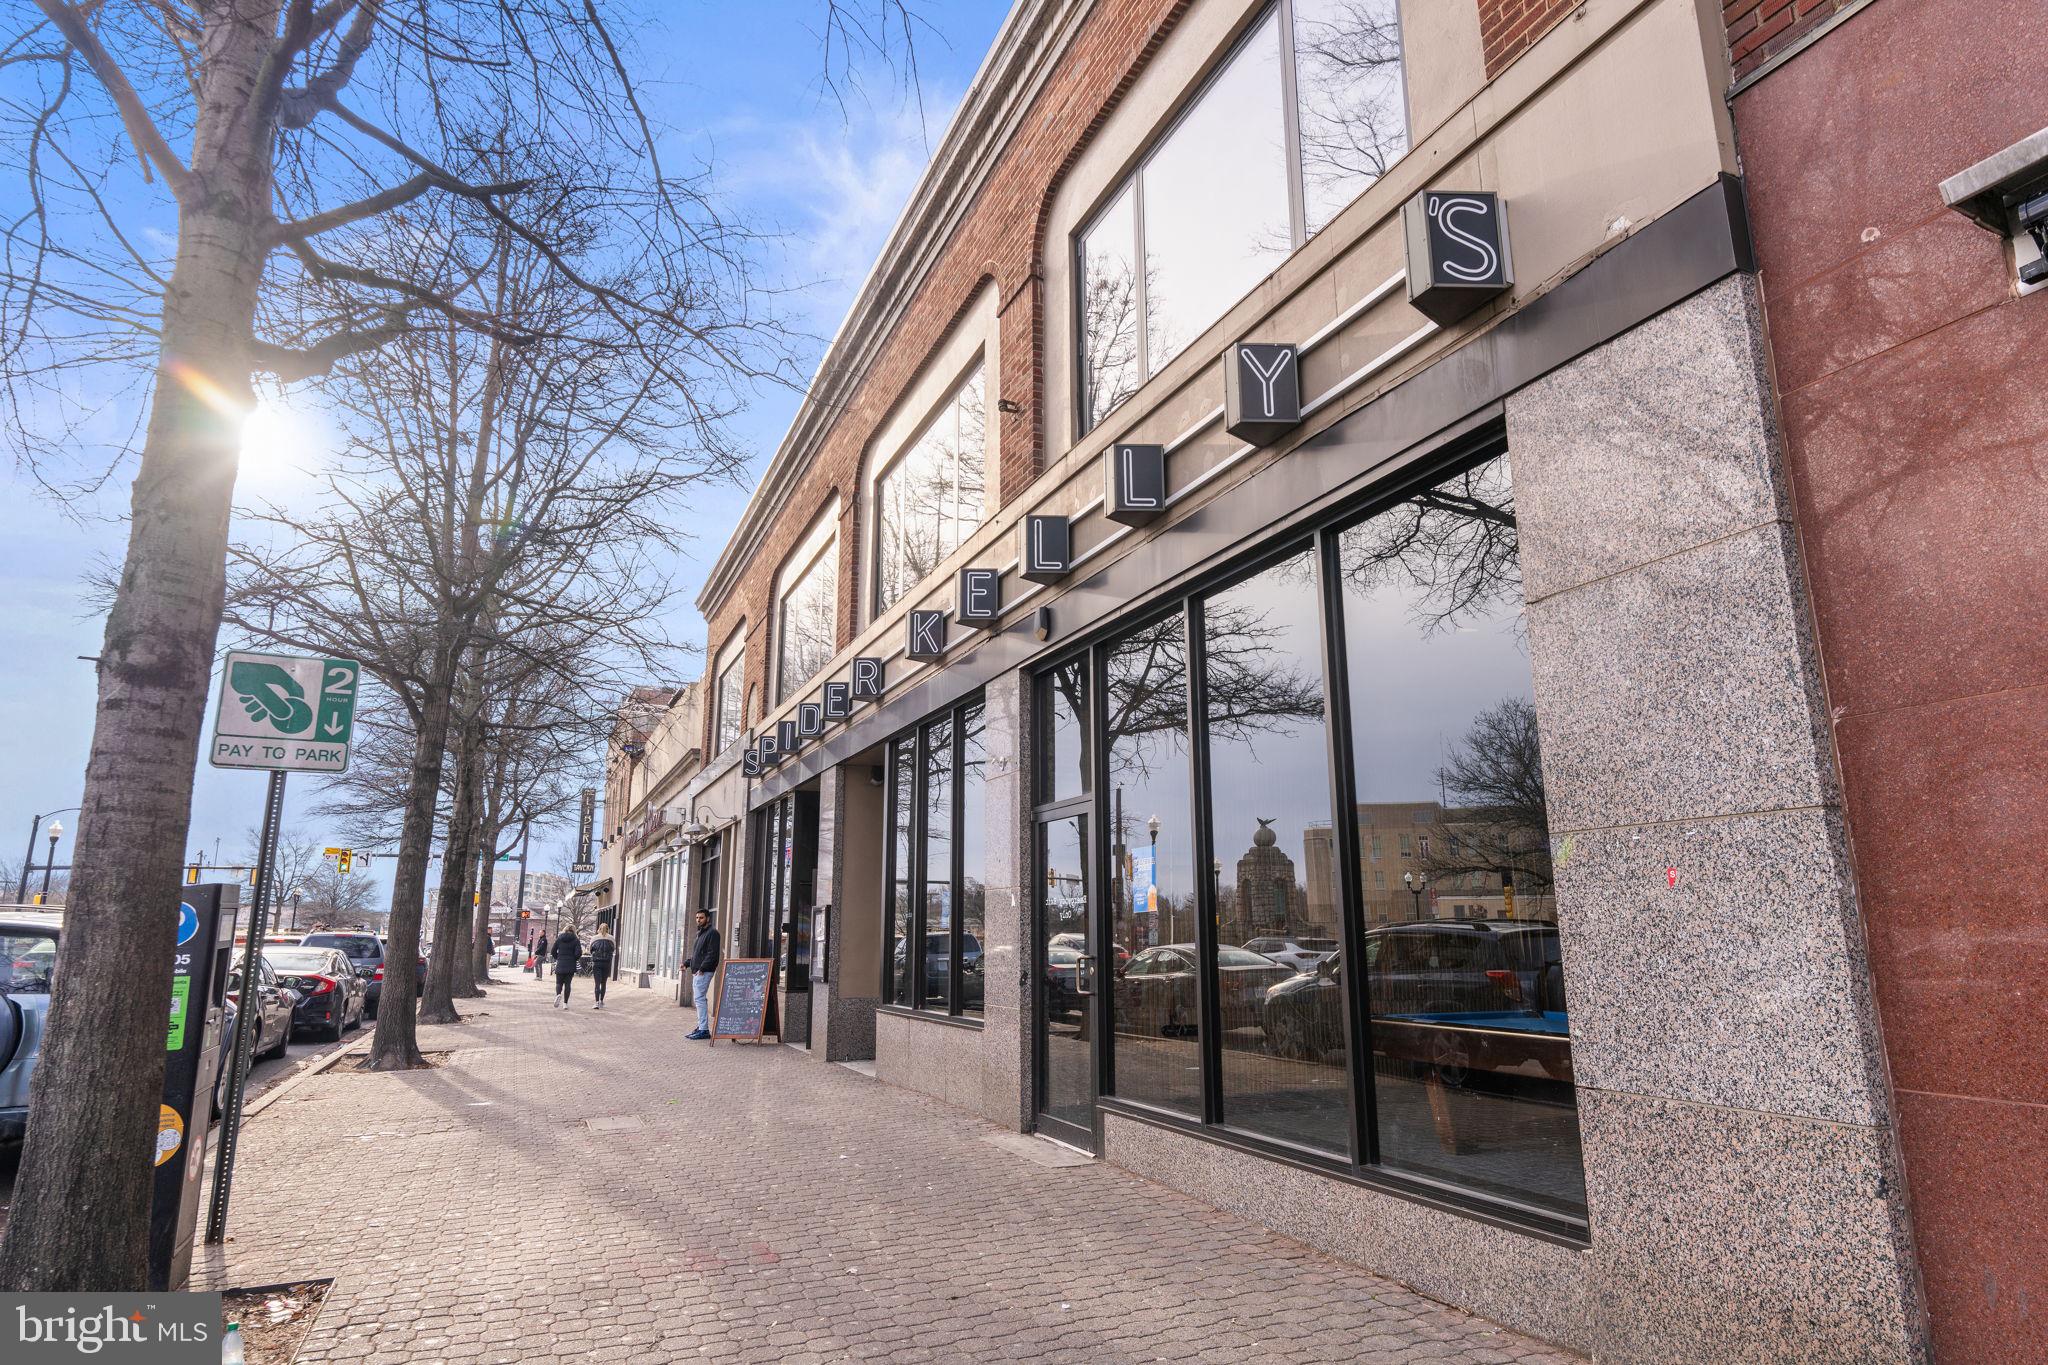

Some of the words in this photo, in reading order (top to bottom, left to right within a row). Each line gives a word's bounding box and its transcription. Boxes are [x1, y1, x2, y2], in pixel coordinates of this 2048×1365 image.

[744, 659, 878, 775] SPIDER
[913, 196, 1498, 654] KELLY'S
[324, 667, 355, 695] 2
[217, 743, 254, 758] PAY
[262, 745, 286, 760] TO
[295, 748, 342, 762] PARK
